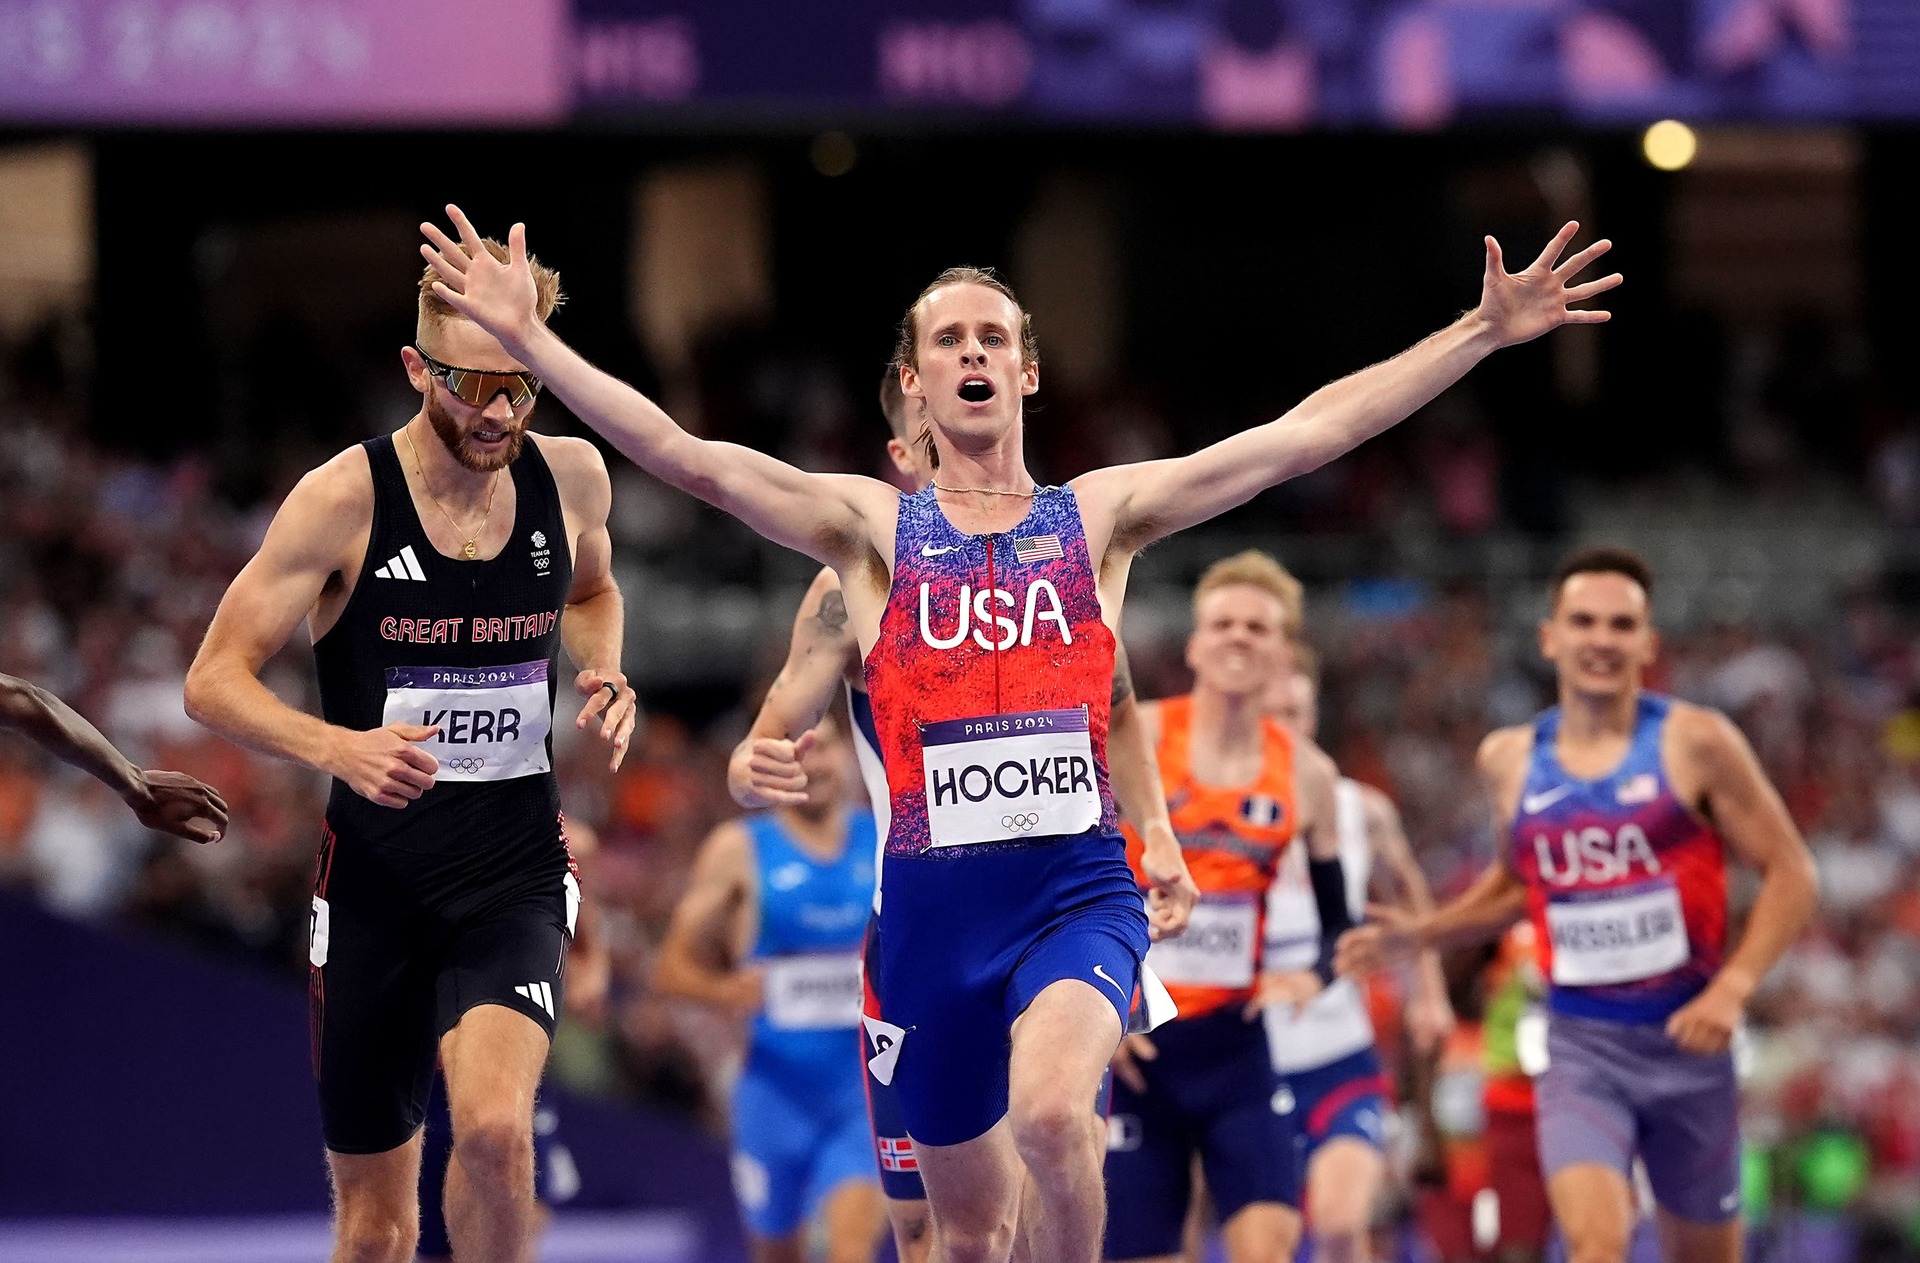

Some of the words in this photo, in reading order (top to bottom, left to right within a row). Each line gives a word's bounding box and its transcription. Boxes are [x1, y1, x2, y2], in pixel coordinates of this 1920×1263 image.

[380, 615, 463, 643] GREAT
[471, 609, 559, 643] BRITAIN
[919, 578, 1073, 651] USA
[432, 672, 475, 684] PARIS
[479, 671, 516, 683] 2024
[422, 708, 521, 744] KERR
[965, 720, 1010, 736] PARIS
[1015, 717, 1054, 732] 2024
[932, 755, 1093, 807] HOCKER
[1533, 823, 1661, 887] USA
